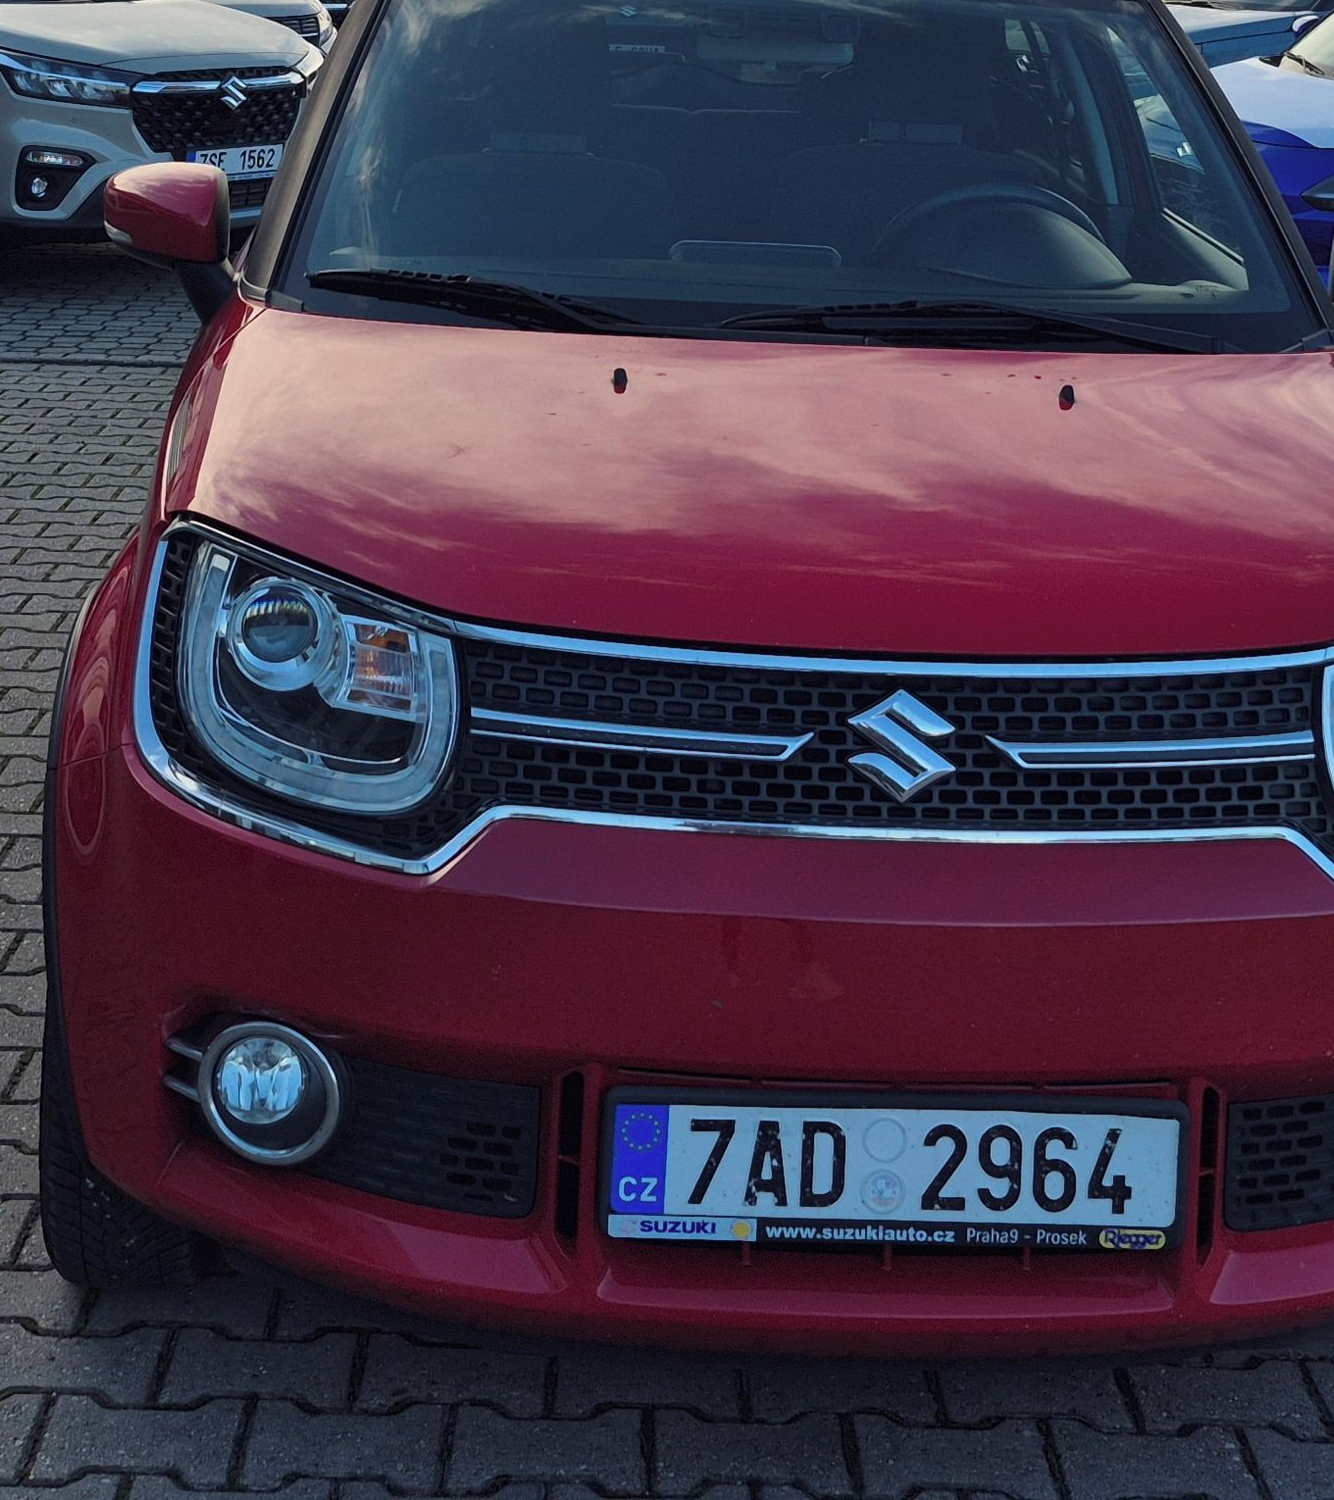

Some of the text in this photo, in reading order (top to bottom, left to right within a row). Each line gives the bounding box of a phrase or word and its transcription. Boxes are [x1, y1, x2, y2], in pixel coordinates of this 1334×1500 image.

[239, 148, 275, 171] 1562
[688, 1119, 1133, 1215] 7AD 2964
[618, 1176, 658, 1202] CZ
[639, 1220, 717, 1234] SUZUKI
[765, 1224, 955, 1243] www.suzukiauto.cz
[1036, 1229, 1087, 1245] Prosek
